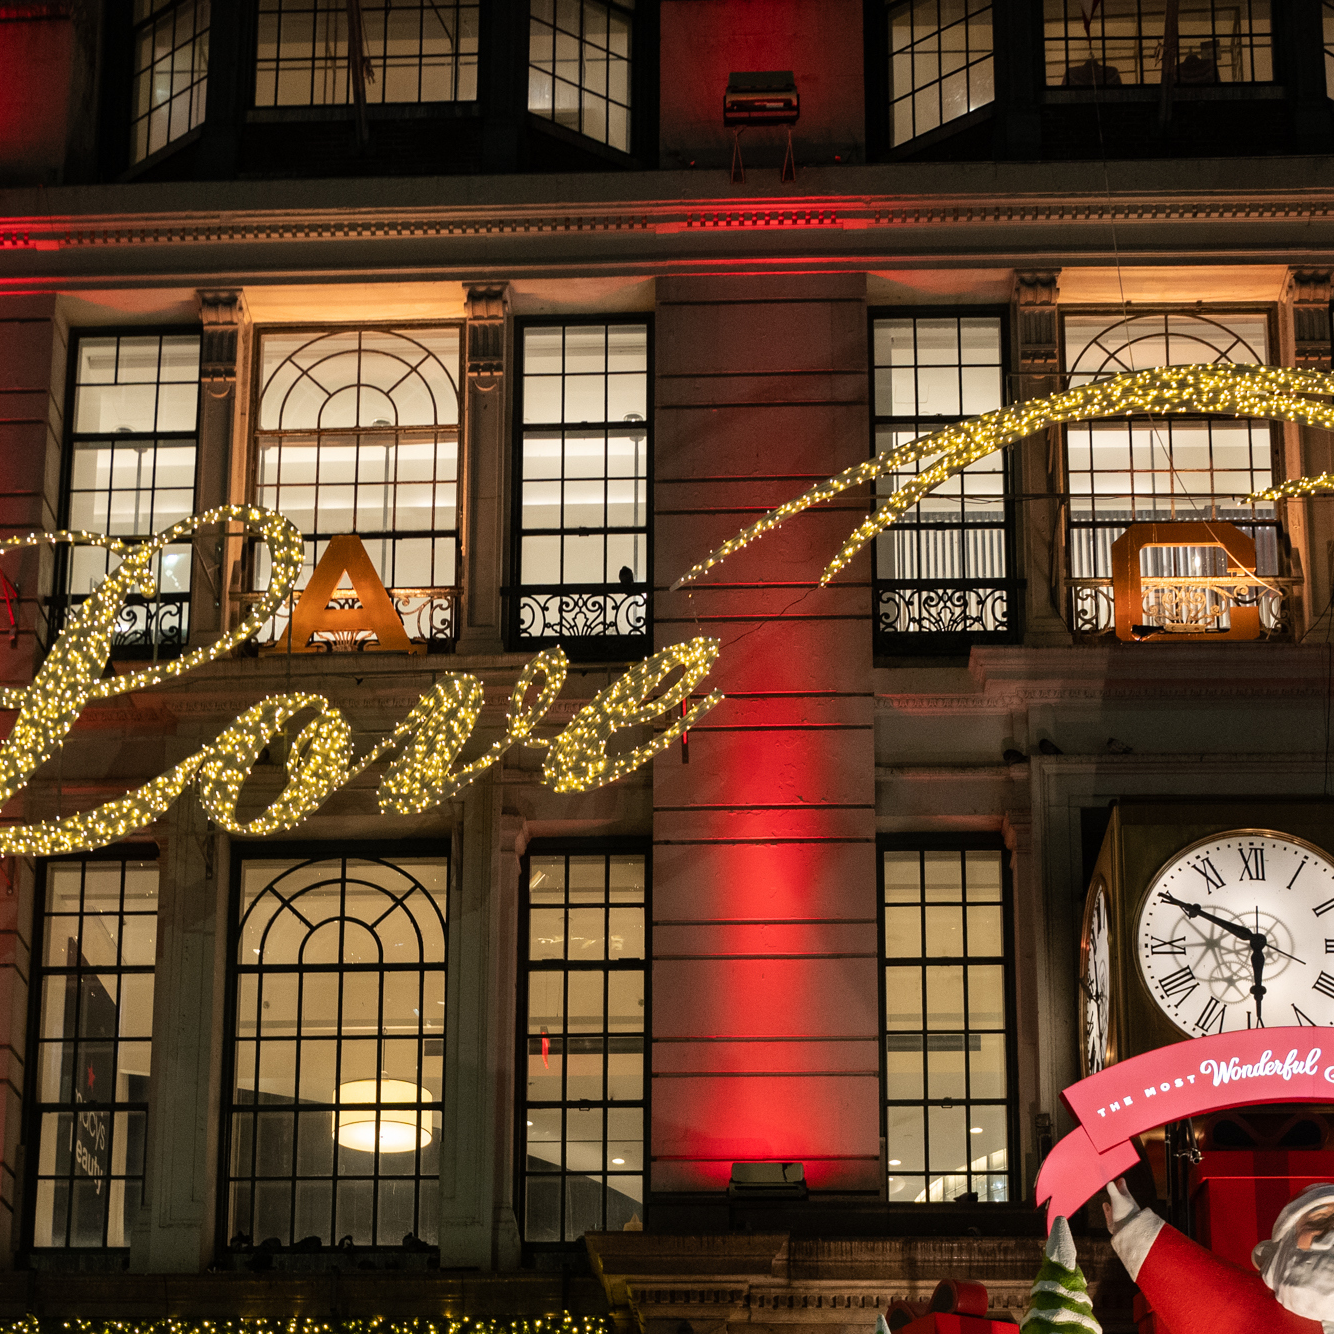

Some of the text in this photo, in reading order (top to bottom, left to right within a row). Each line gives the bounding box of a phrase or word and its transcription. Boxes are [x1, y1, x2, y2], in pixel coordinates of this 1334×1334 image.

[1192, 857, 1226, 895] XI
[1238, 848, 1267, 881] XII
[1287, 859, 1307, 890] I
[1151, 936, 1186, 955] IX
[1097, 1096, 1134, 1118] THE
[1144, 1074, 1196, 1098] MOST
[1199, 1047, 1323, 1087] Wonderful
